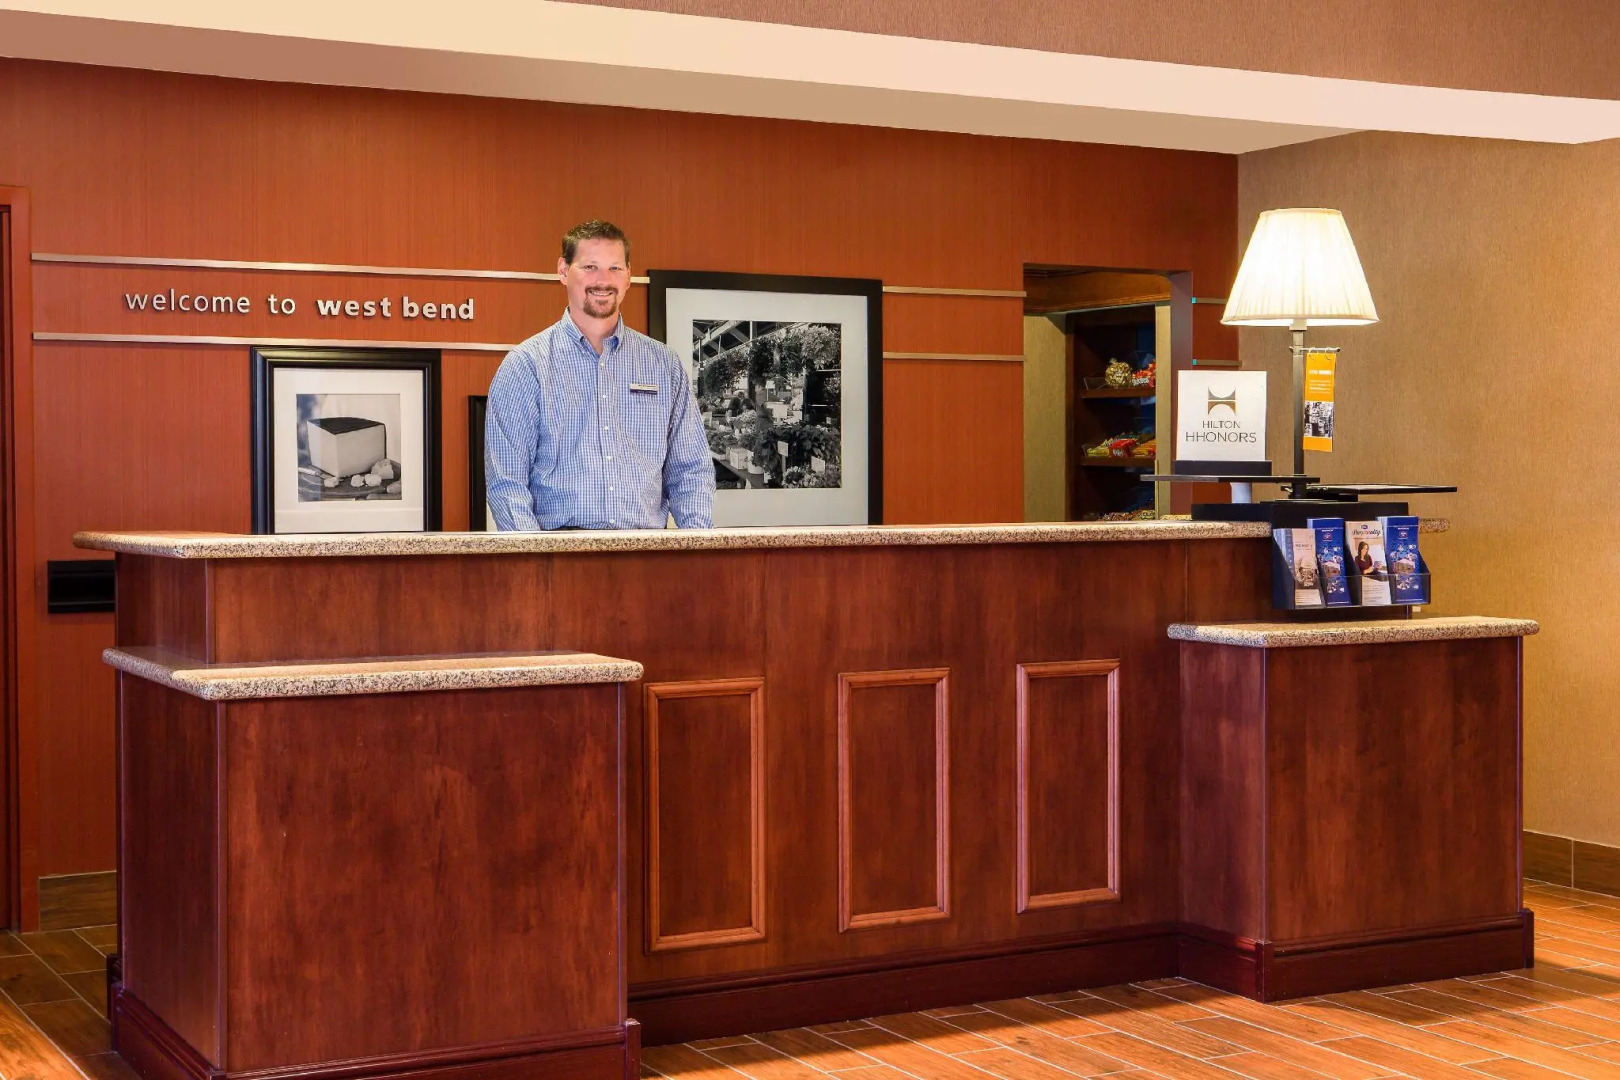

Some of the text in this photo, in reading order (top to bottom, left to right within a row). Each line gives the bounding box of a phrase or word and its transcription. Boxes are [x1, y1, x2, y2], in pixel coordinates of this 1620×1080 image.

[125, 288, 475, 320] welcome to west bend
[1202, 420, 1241, 429] HILTON
[1185, 431, 1257, 443] HHONORS
